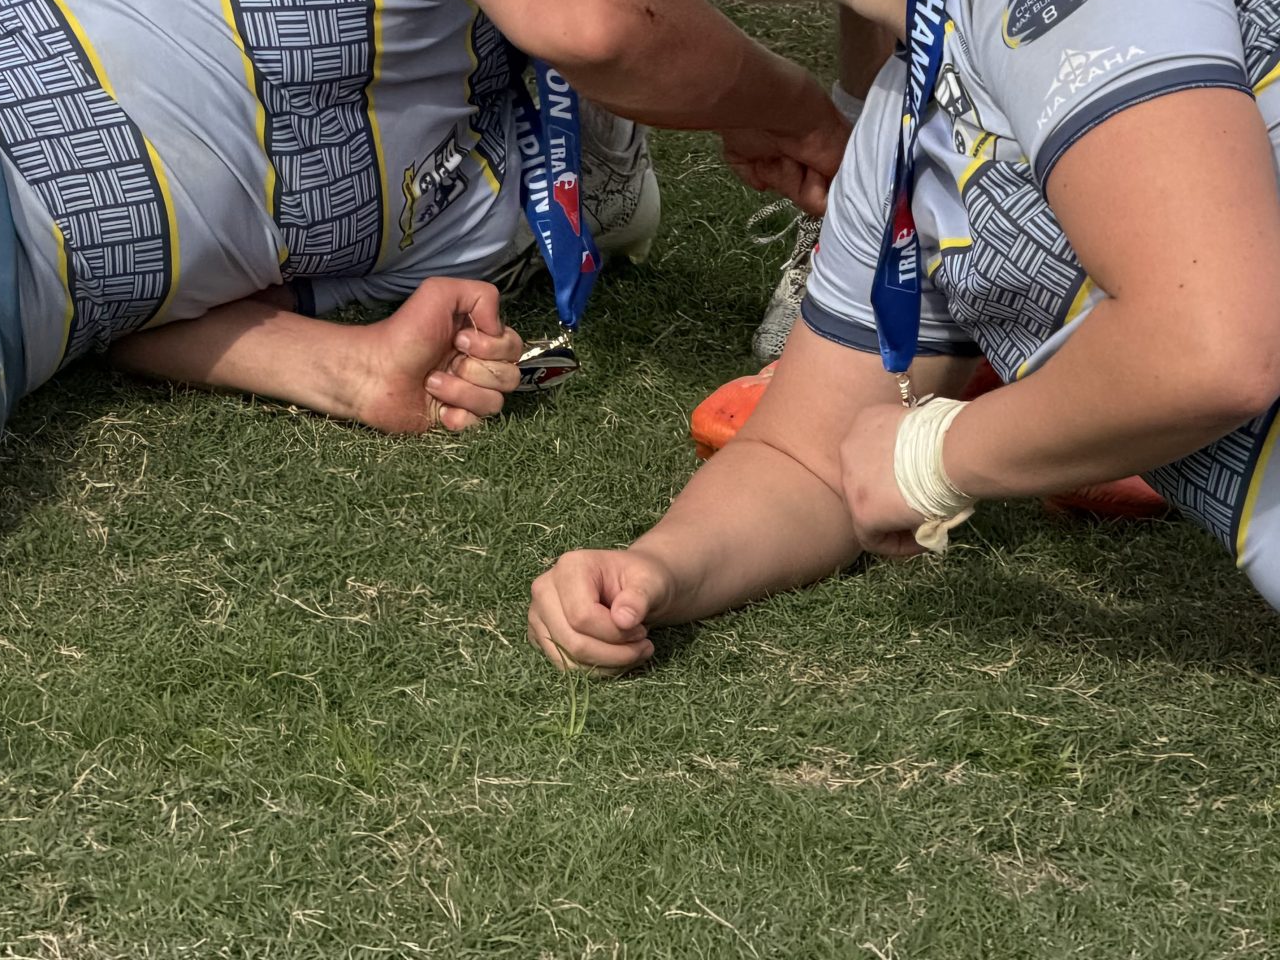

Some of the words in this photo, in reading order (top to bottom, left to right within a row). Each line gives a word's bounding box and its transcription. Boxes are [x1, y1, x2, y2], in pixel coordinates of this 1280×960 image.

[1011, 10, 1032, 34] MAX
[1042, 5, 1058, 24] 8
[1036, 95, 1065, 131] KIA
[1070, 45, 1146, 94] KAHA
[549, 135, 567, 172] TRA
